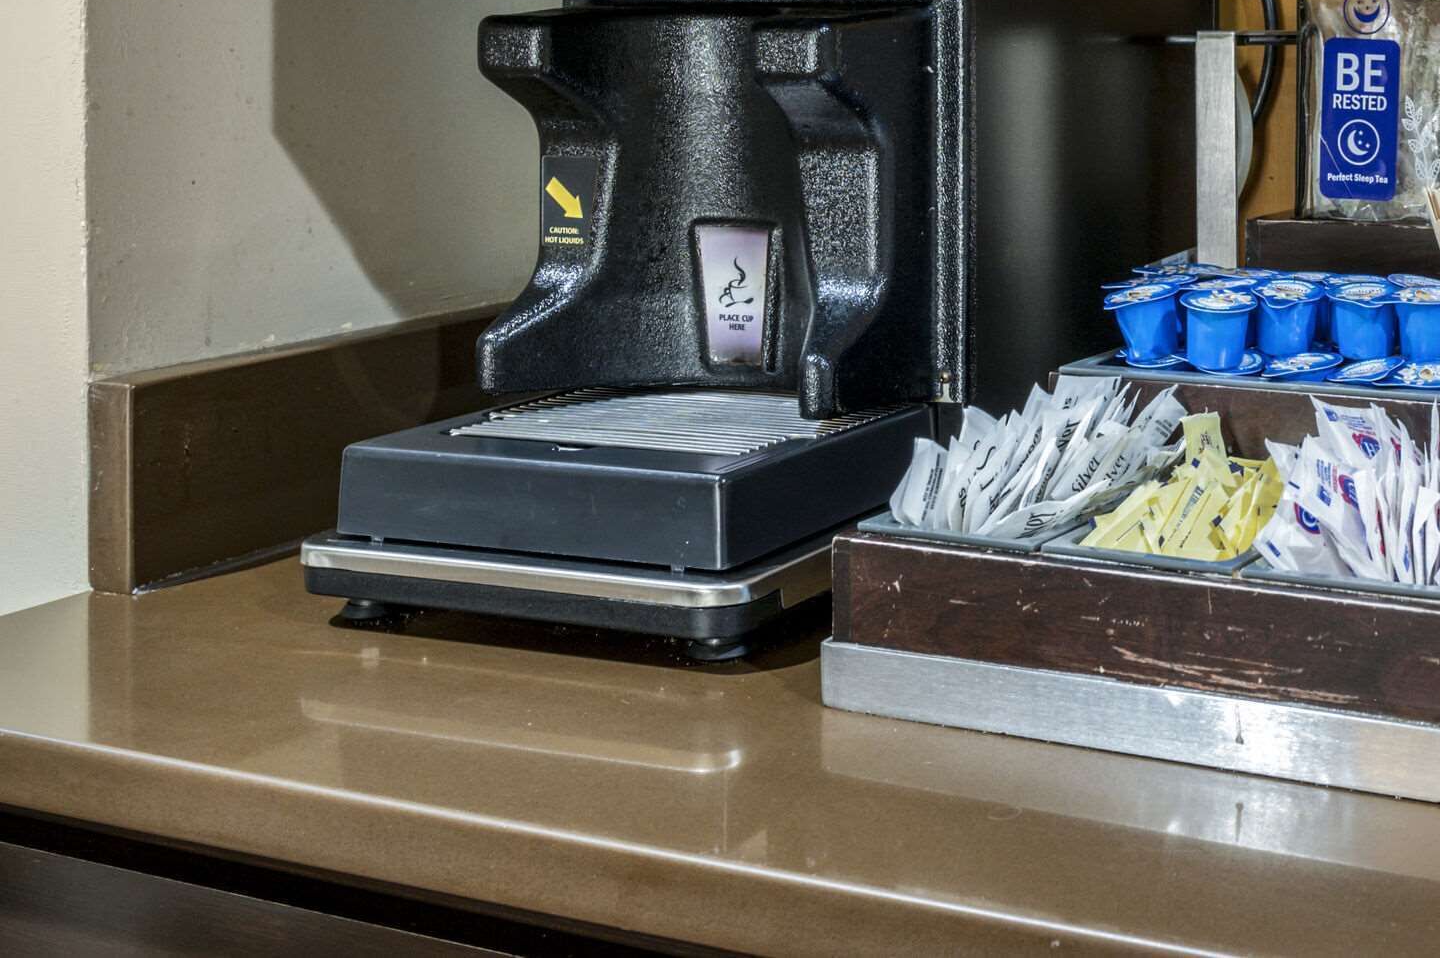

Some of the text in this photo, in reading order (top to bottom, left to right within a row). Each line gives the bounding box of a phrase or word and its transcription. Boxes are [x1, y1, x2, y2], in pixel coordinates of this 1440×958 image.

[1336, 52, 1386, 93] BE
[1332, 93, 1388, 112] RESTED
[1327, 172, 1388, 185] Perfect Sleep Tea
[558, 236, 584, 245] LIQUIDS
[719, 313, 753, 322] PLACE CUP
[729, 323, 745, 331] HERE
[1071, 455, 1102, 499] Silver
